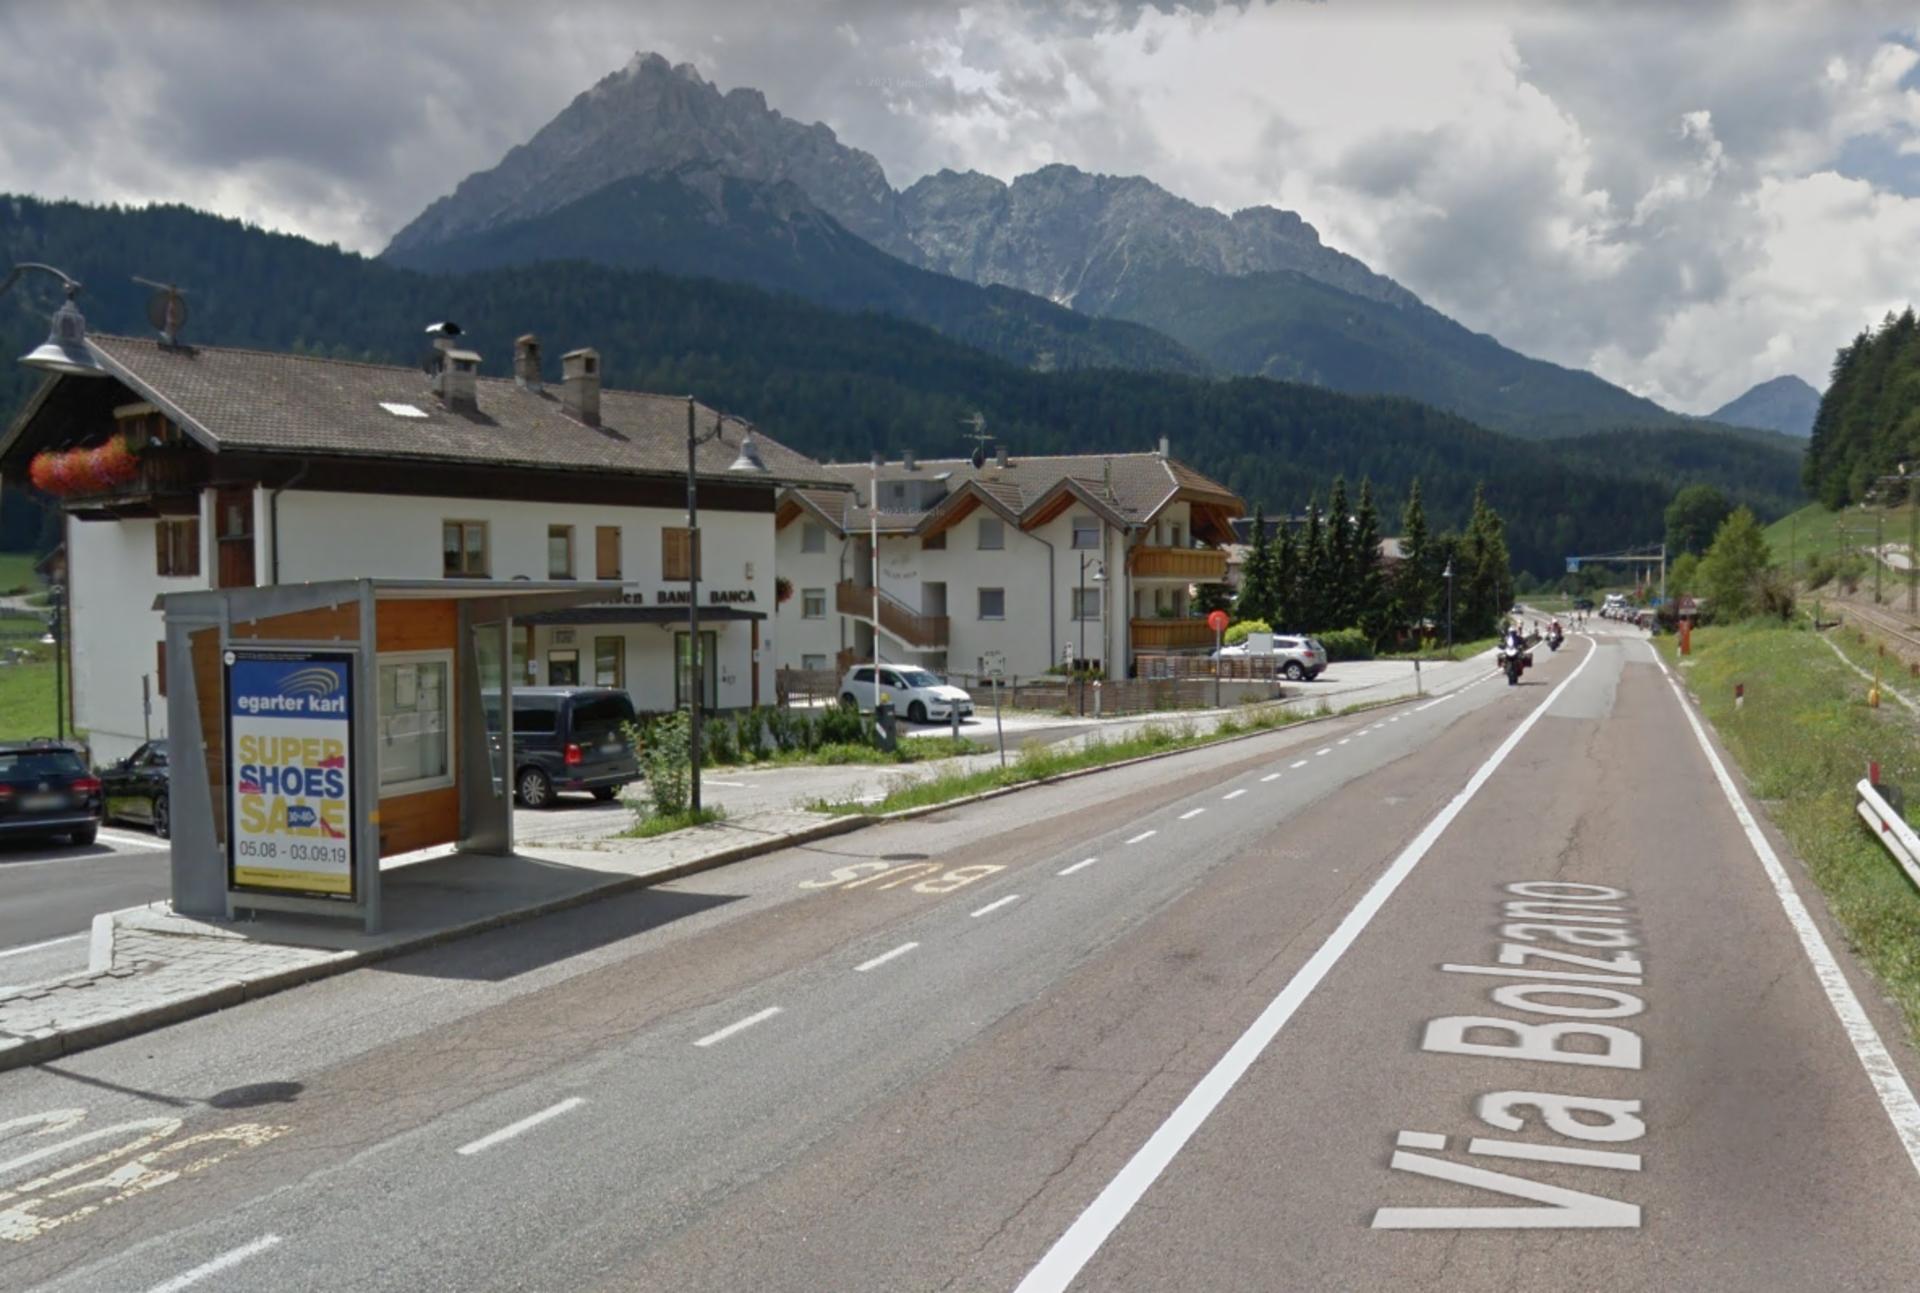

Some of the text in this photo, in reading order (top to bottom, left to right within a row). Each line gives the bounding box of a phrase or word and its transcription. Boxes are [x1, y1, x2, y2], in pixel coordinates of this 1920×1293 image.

[710, 590, 756, 603] BANCA
[238, 694, 345, 713] egarter karl
[239, 734, 344, 767] SUPER
[239, 764, 344, 799] SHOES
[240, 841, 277, 858] 05.08
[291, 843, 346, 863] 03.09.19
[797, 861, 1008, 894] BUS
